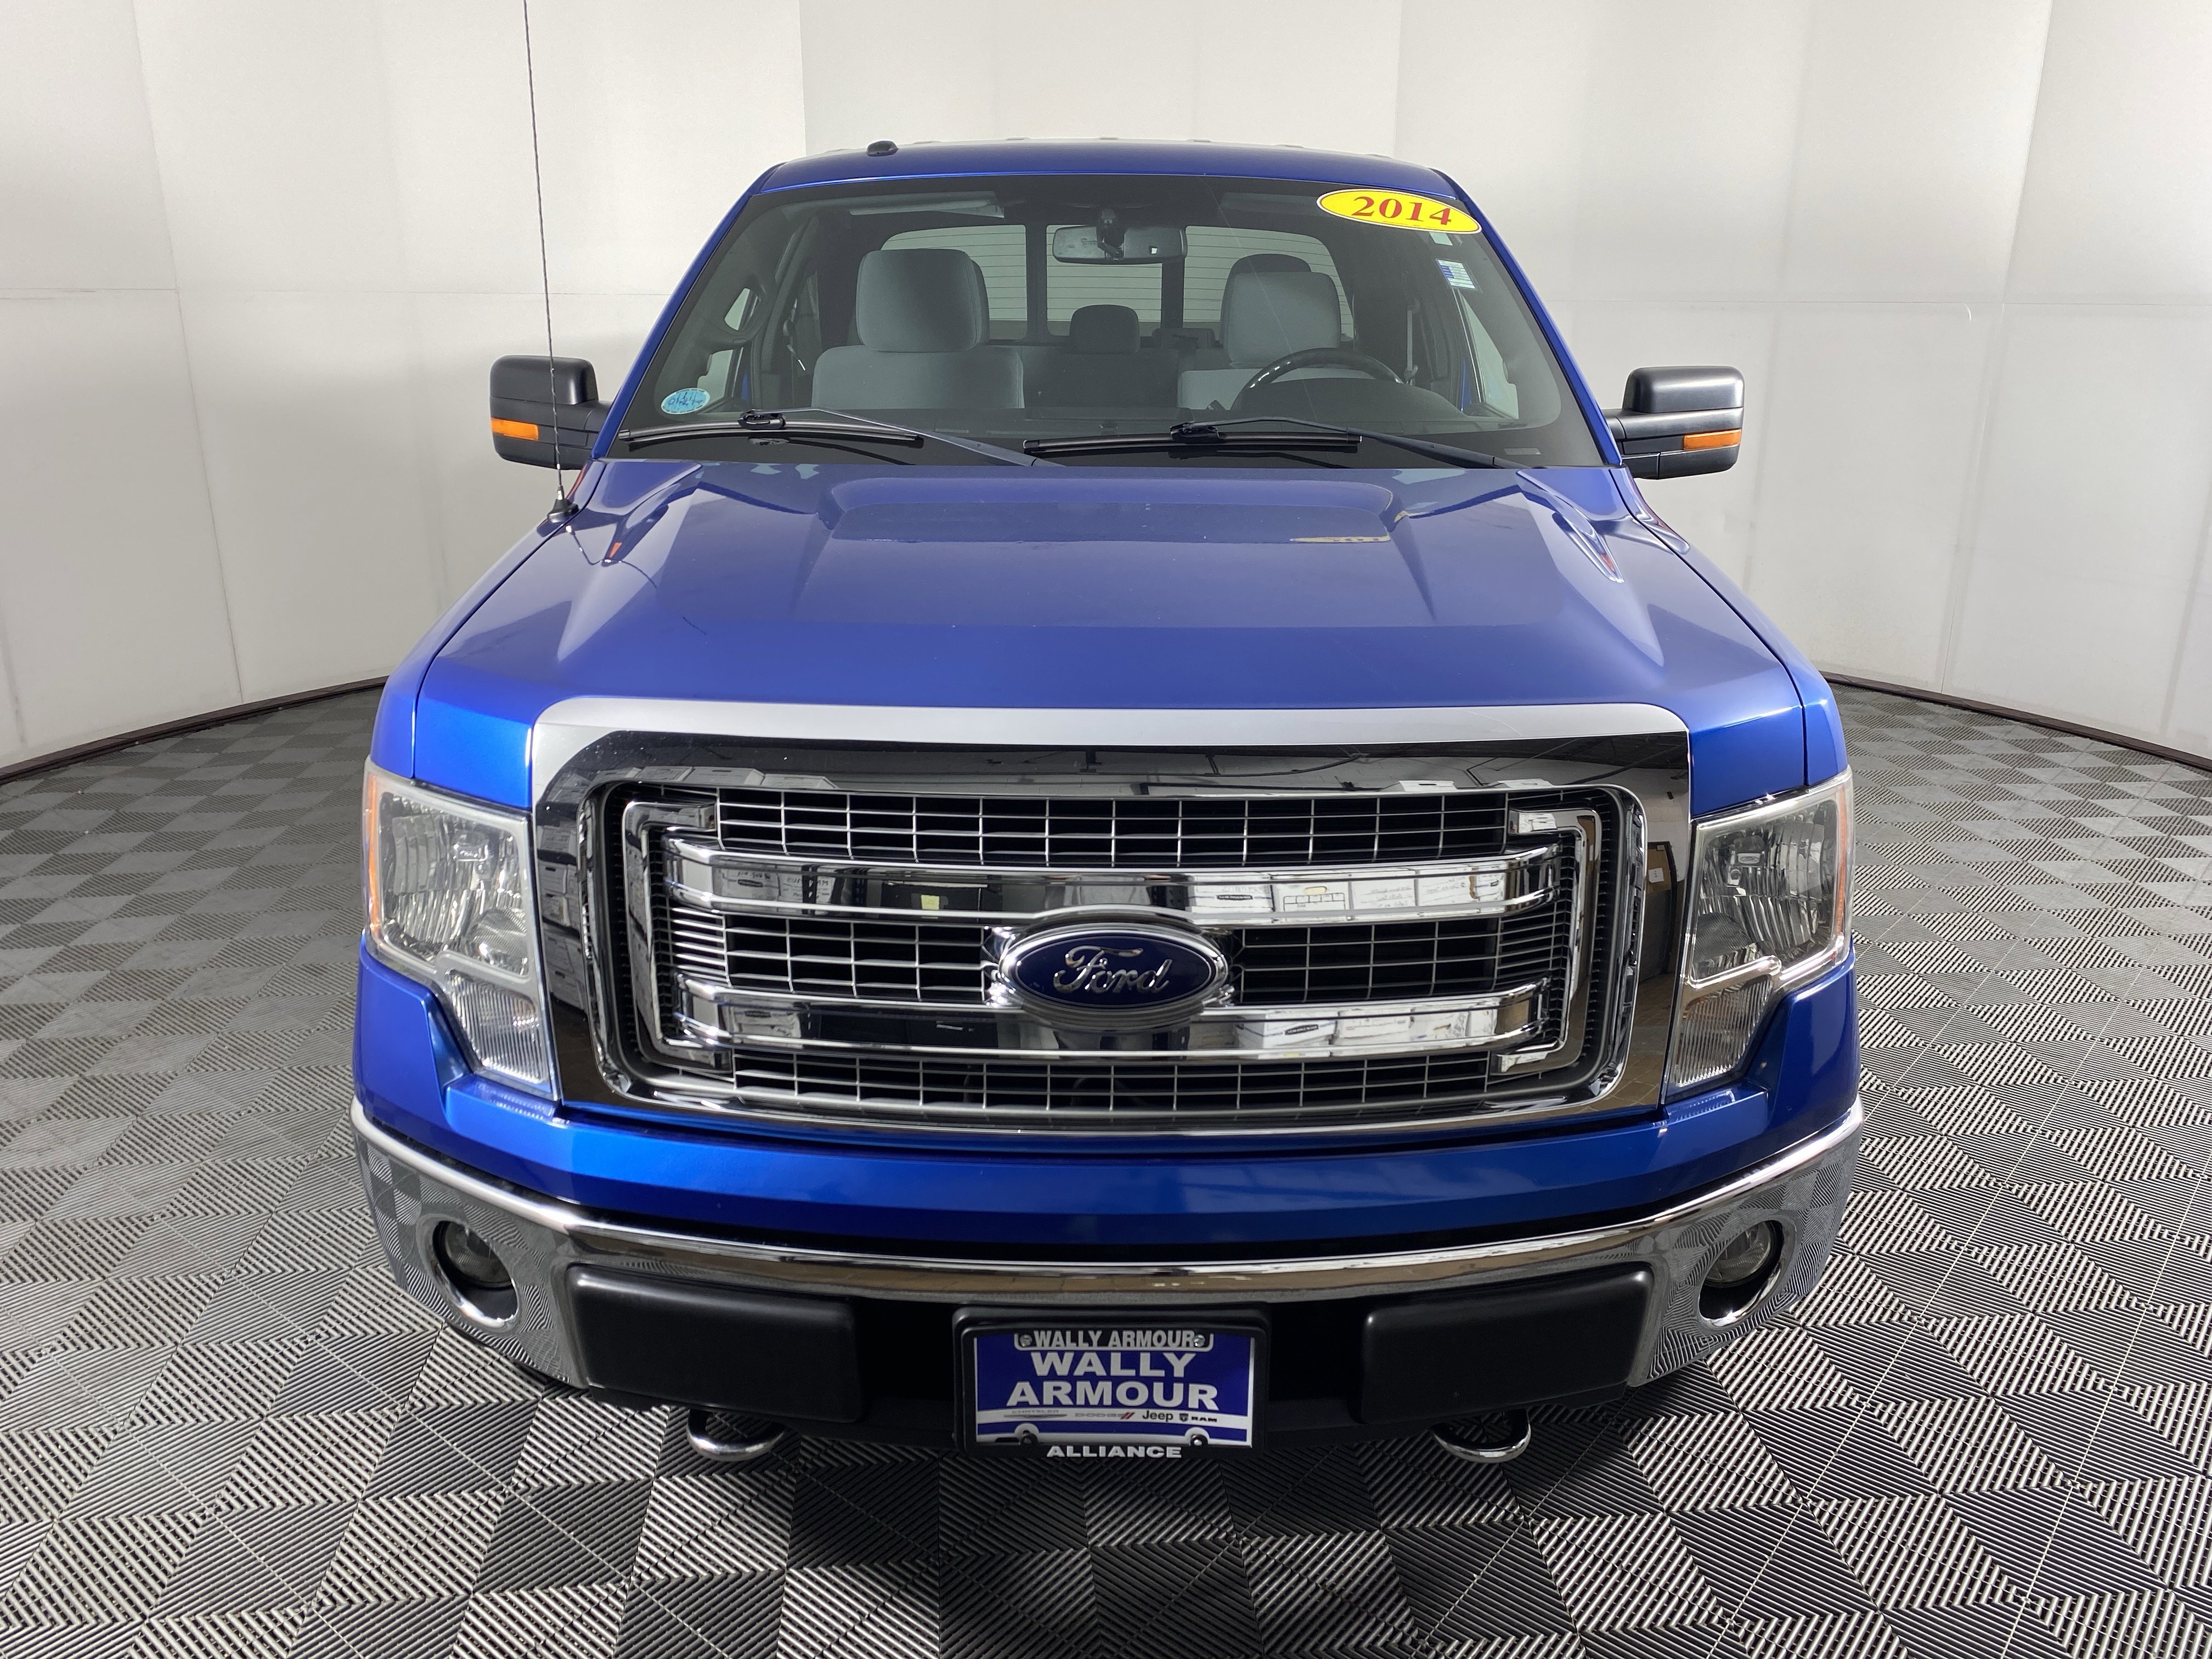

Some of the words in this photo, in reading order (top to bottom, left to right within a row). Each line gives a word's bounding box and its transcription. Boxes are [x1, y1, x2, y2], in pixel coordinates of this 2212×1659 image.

[1351, 196, 1452, 225] 2014
[1053, 945, 1173, 994] Ford
[1034, 1330, 1102, 1348] WALLY
[1108, 1330, 1195, 1348] ARMOUR
[1031, 1351, 1197, 1378] WALLY
[1006, 1380, 1220, 1411] ARMOUR
[1142, 1410, 1173, 1423] Jeep
[1046, 1445, 1182, 1458] ALLIANCE
